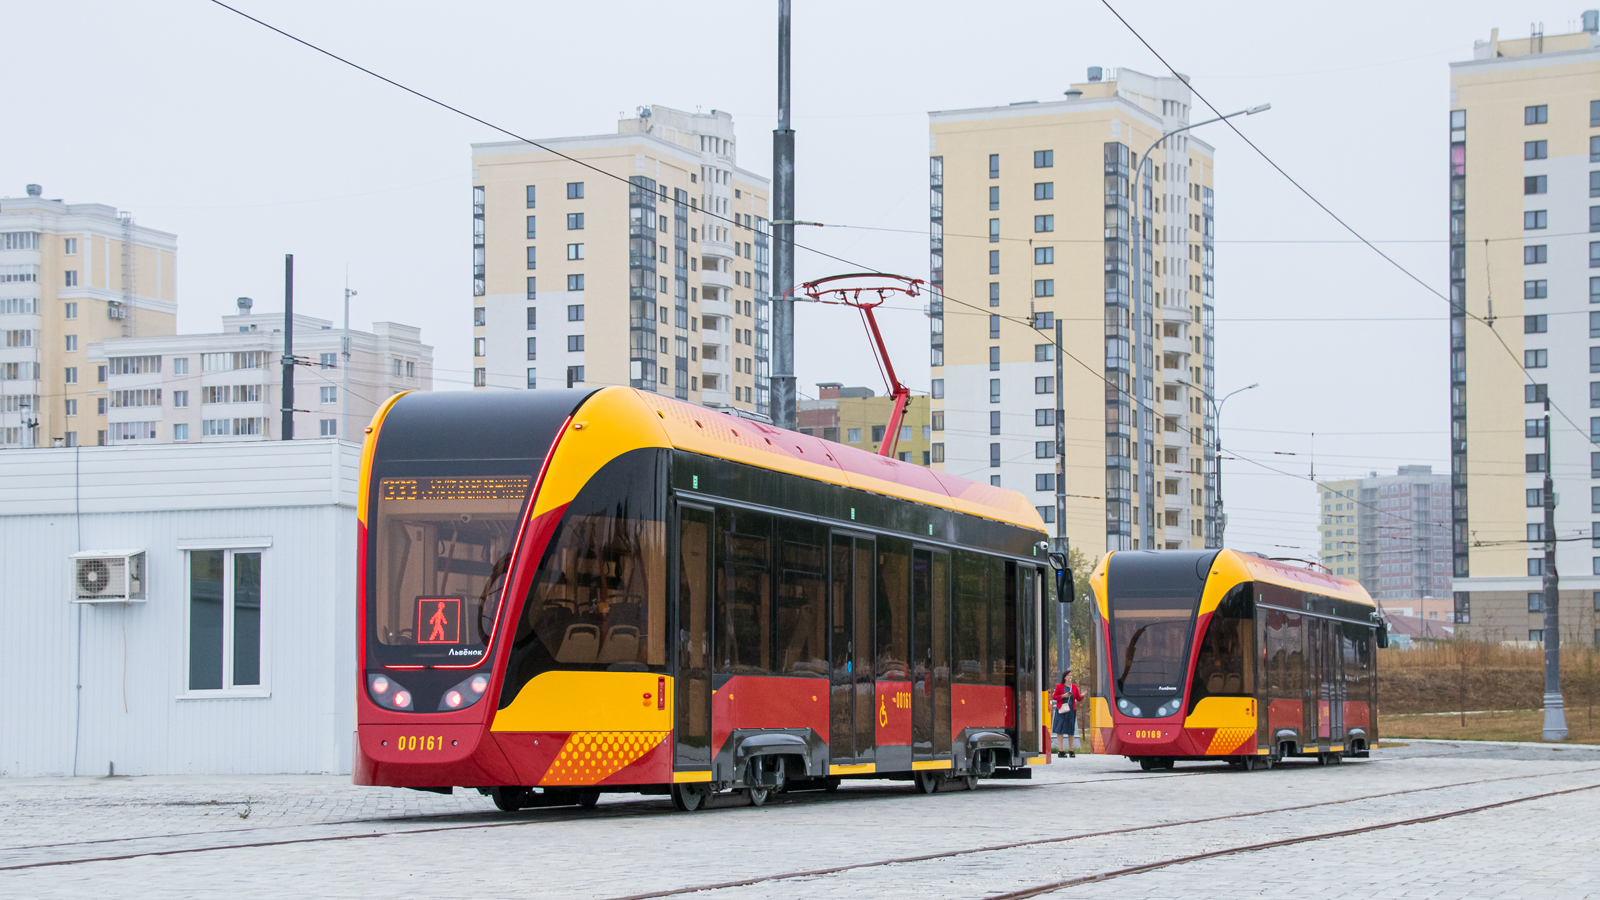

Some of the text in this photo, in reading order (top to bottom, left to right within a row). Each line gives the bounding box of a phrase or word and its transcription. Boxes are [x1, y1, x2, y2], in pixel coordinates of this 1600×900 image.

[448, 648, 483, 656] Львёнок
[896, 691, 911, 709] 00161
[1135, 730, 1162, 739] 00169
[398, 735, 443, 751] 00161
